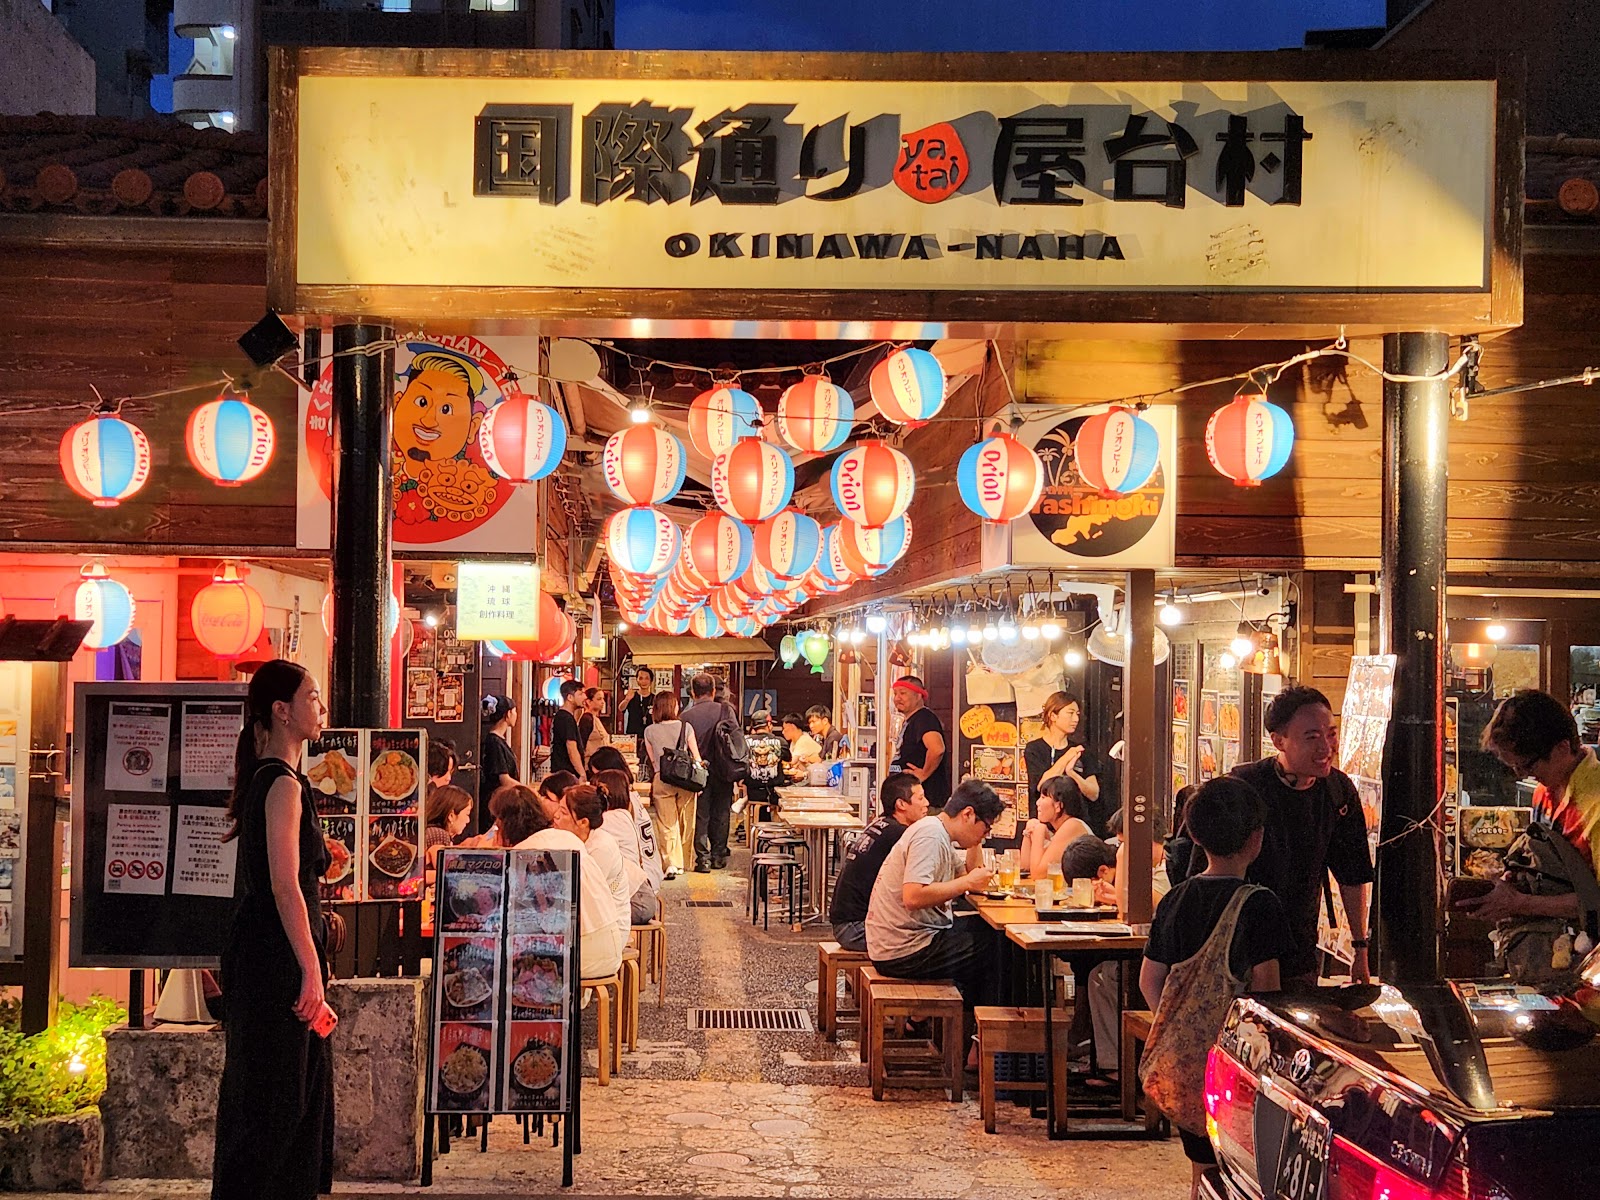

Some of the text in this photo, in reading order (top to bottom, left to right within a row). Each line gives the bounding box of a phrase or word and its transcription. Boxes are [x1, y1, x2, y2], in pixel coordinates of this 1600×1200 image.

[473, 109, 866, 207] 国際通り
[993, 114, 1313, 209] 屋台村
[251, 413, 272, 467] Orion
[606, 436, 621, 488] Orion
[1110, 420, 1125, 474] オリオンビール
[713, 453, 729, 505] Orion
[841, 458, 861, 511] Orion
[982, 449, 1002, 502] Orion
[657, 518, 673, 562] Orion
[479, 610, 515, 619] 創作料理
[639, 820, 656, 859] 5
